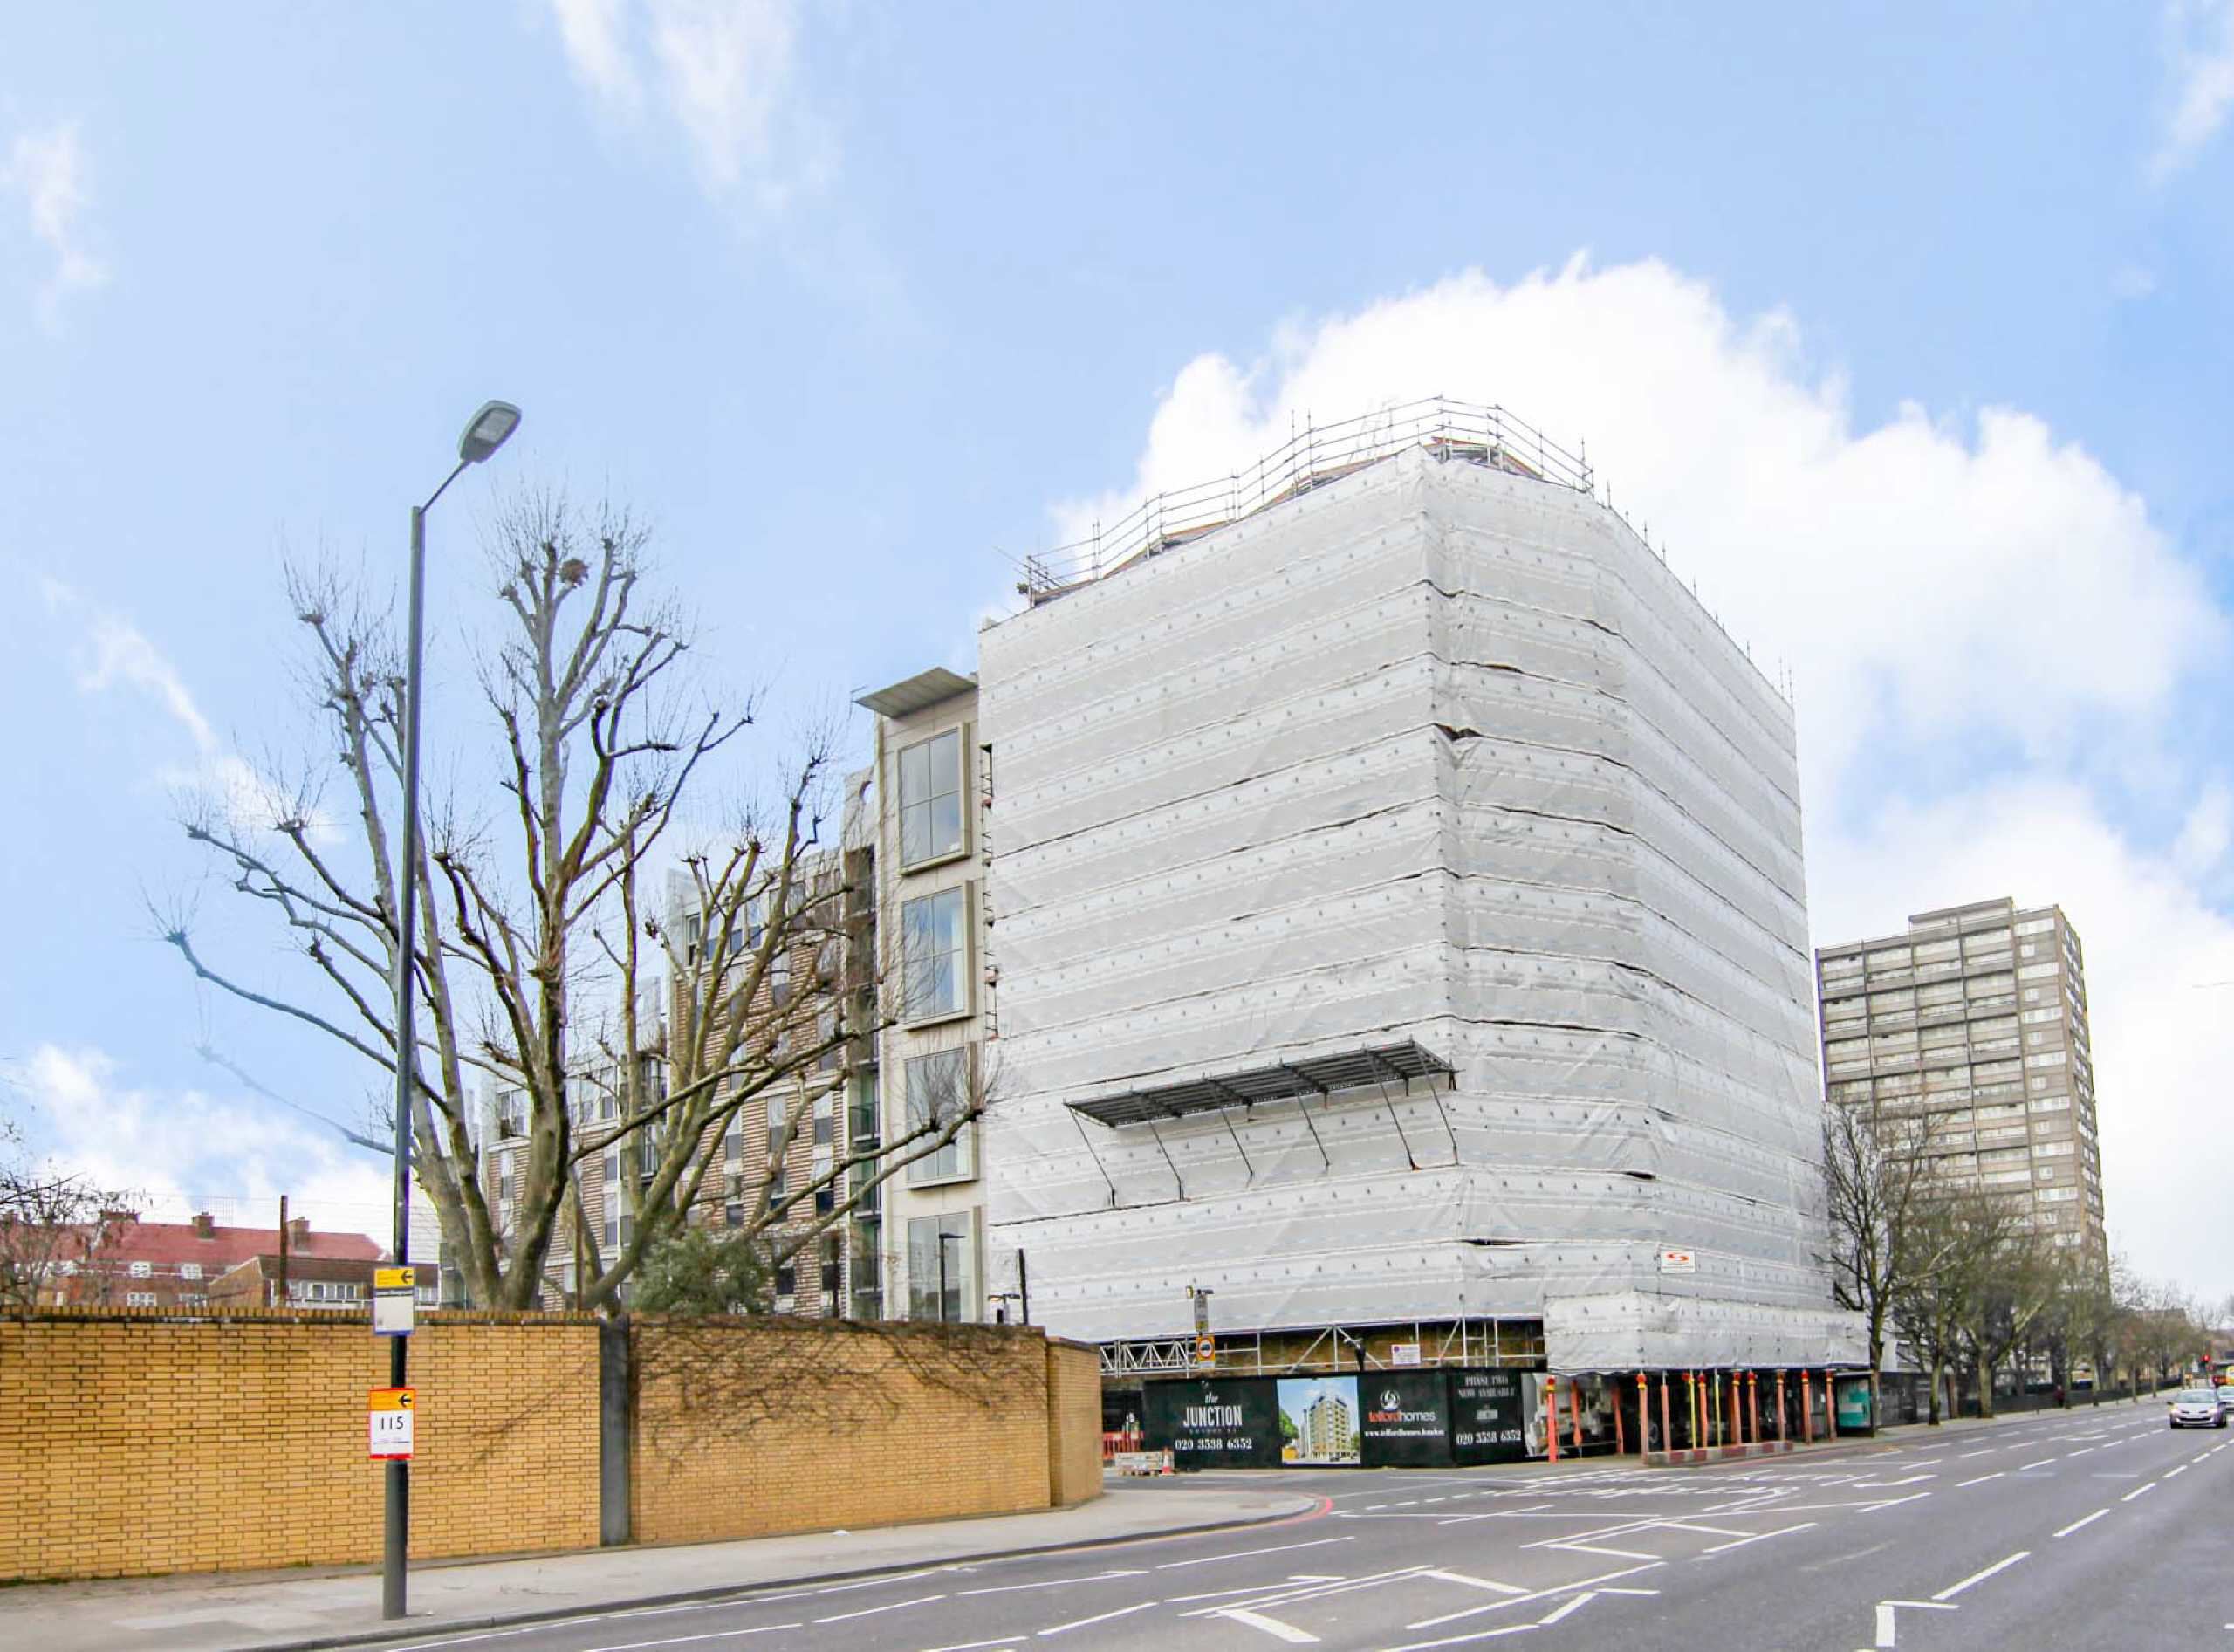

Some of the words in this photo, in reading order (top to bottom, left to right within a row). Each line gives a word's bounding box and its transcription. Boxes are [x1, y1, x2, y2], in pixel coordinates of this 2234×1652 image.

[1204, 1391, 1218, 1404] the
[1182, 1405, 1243, 1428] JUNCTION
[1367, 1409, 1436, 1422] telfordhomes
[380, 1416, 404, 1430] 115
[1175, 1438, 1194, 1450] 020
[1197, 1438, 1223, 1450] 3538
[1226, 1437, 1252, 1450] 6352
[1456, 1433, 1474, 1446] 020
